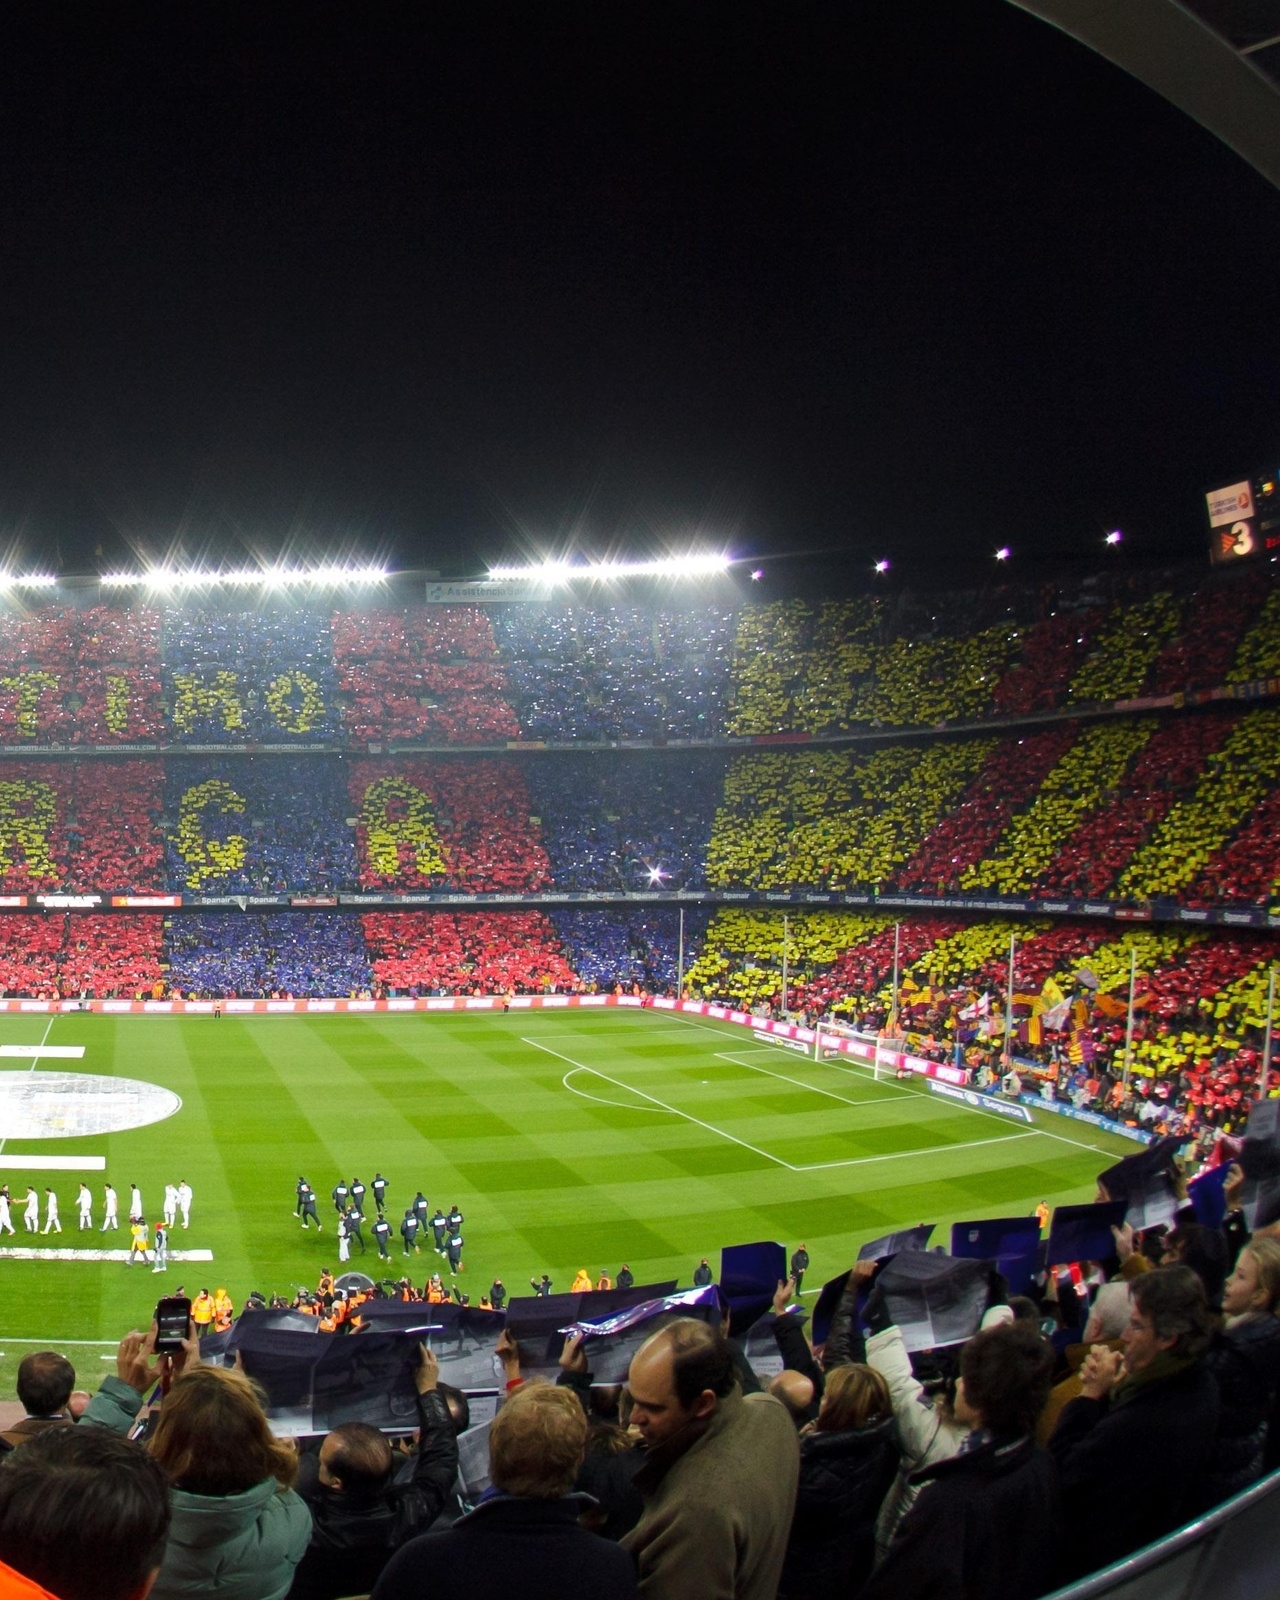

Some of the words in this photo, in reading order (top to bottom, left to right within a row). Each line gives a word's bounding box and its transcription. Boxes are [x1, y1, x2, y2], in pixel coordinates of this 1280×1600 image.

[1231, 521, 1253, 556] 3
[354, 895, 383, 903] Spanair
[401, 895, 431, 903] Spanair
